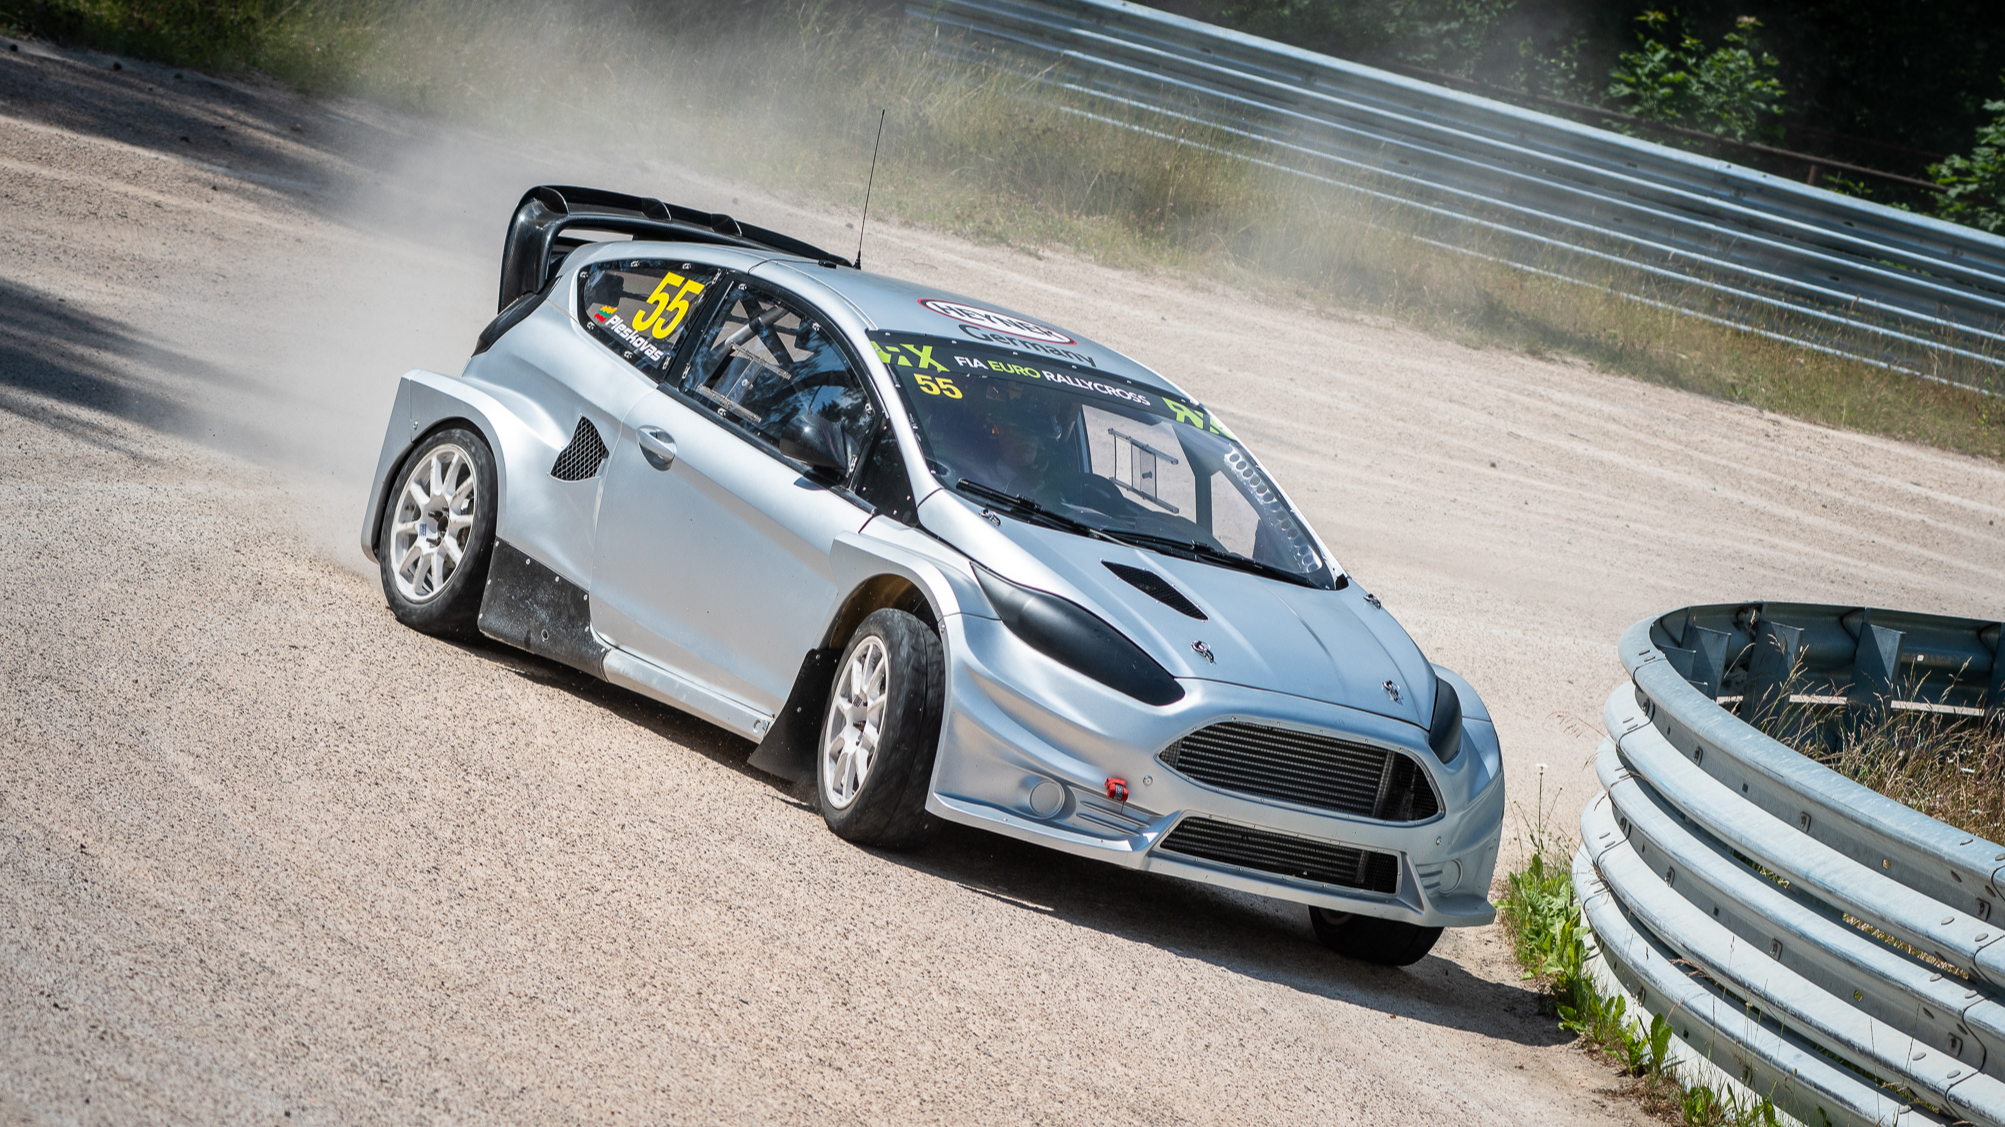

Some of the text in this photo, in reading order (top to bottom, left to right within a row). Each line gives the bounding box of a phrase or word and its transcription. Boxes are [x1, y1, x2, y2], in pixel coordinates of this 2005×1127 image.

[632, 271, 705, 339] 55
[931, 301, 1065, 341] HEYNER
[604, 314, 664, 362] Pleskovas
[958, 323, 1097, 368] Germany
[913, 373, 963, 399] 55
[953, 355, 1151, 406] FIA EURO RALLYCROSS
